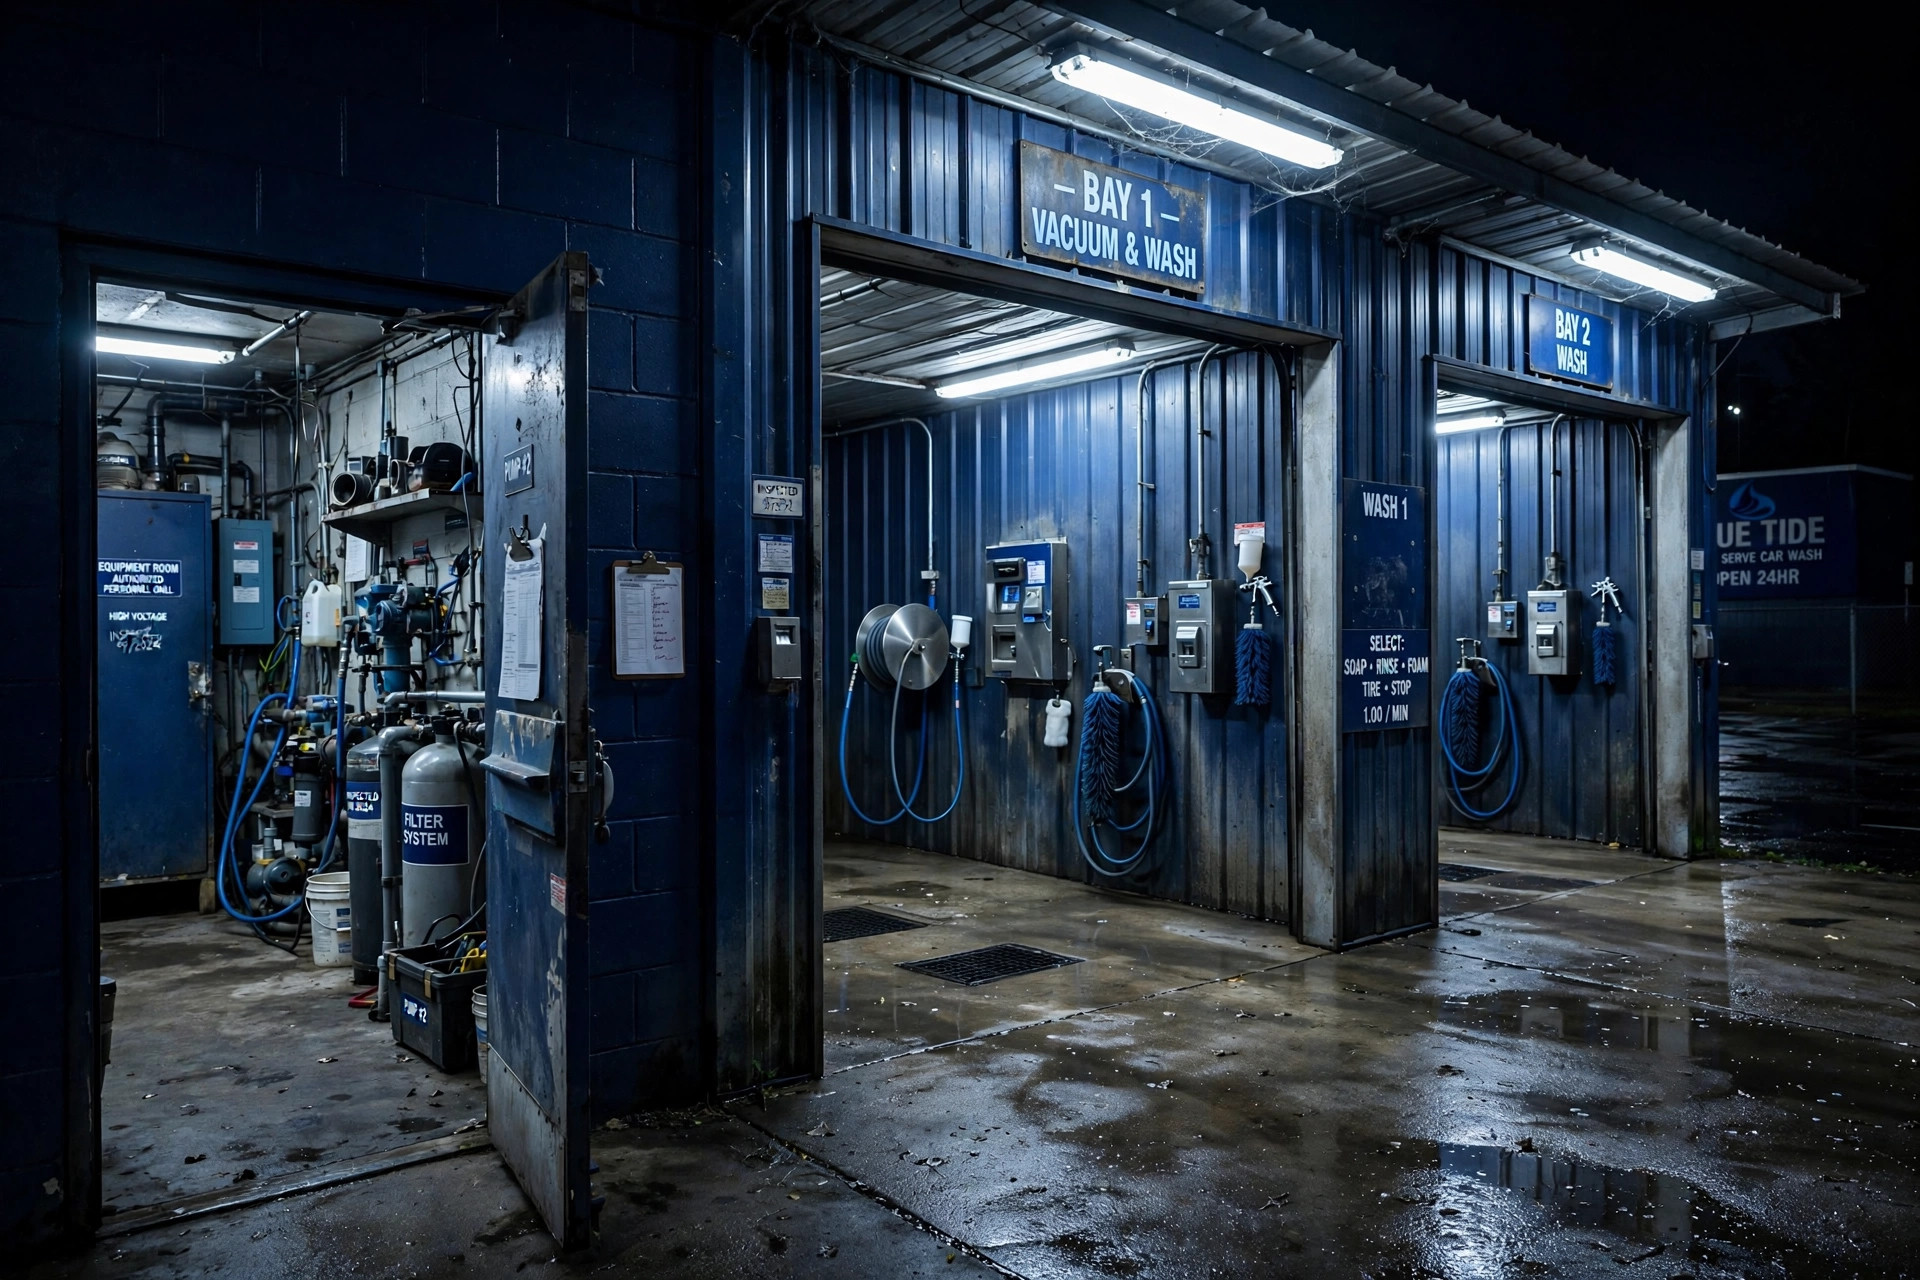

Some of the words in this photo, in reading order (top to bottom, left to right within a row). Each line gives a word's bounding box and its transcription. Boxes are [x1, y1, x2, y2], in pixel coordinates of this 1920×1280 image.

[1083, 169, 1132, 221] BAY
[1141, 188, 1152, 228] 1
[1031, 206, 1119, 262] VACUUM
[1125, 231, 1139, 266] &
[1144, 235, 1197, 280] WASH
[1555, 308, 1580, 343] BAY
[1582, 317, 1591, 346] 2
[1556, 343, 1588, 376] WASH
[1363, 491, 1398, 519] WASH
[1401, 496, 1408, 520] 1
[1760, 516, 1825, 546] TIDE
[1721, 551, 1756, 564] SERVE
[1760, 550, 1784, 562] CAR
[1788, 548, 1823, 561] WASH
[98, 561, 151, 573] EQUIPMENT
[152, 563, 179, 574] ROOM
[1757, 568, 1800, 585] 24HR
[109, 611, 130, 620] HIGH
[1369, 634, 1405, 651] SELECT:
[1344, 658, 1367, 675] SOAP
[1376, 657, 1399, 675] RINSE
[1407, 656, 1429, 673] FOAM
[1362, 681, 1381, 697] TIRE
[1391, 680, 1412, 696] STOP
[1363, 705, 1383, 723] 1.00
[1392, 704, 1409, 722] MIN
[404, 812, 444, 829] FILTER
[403, 829, 449, 846] SYSTEM
